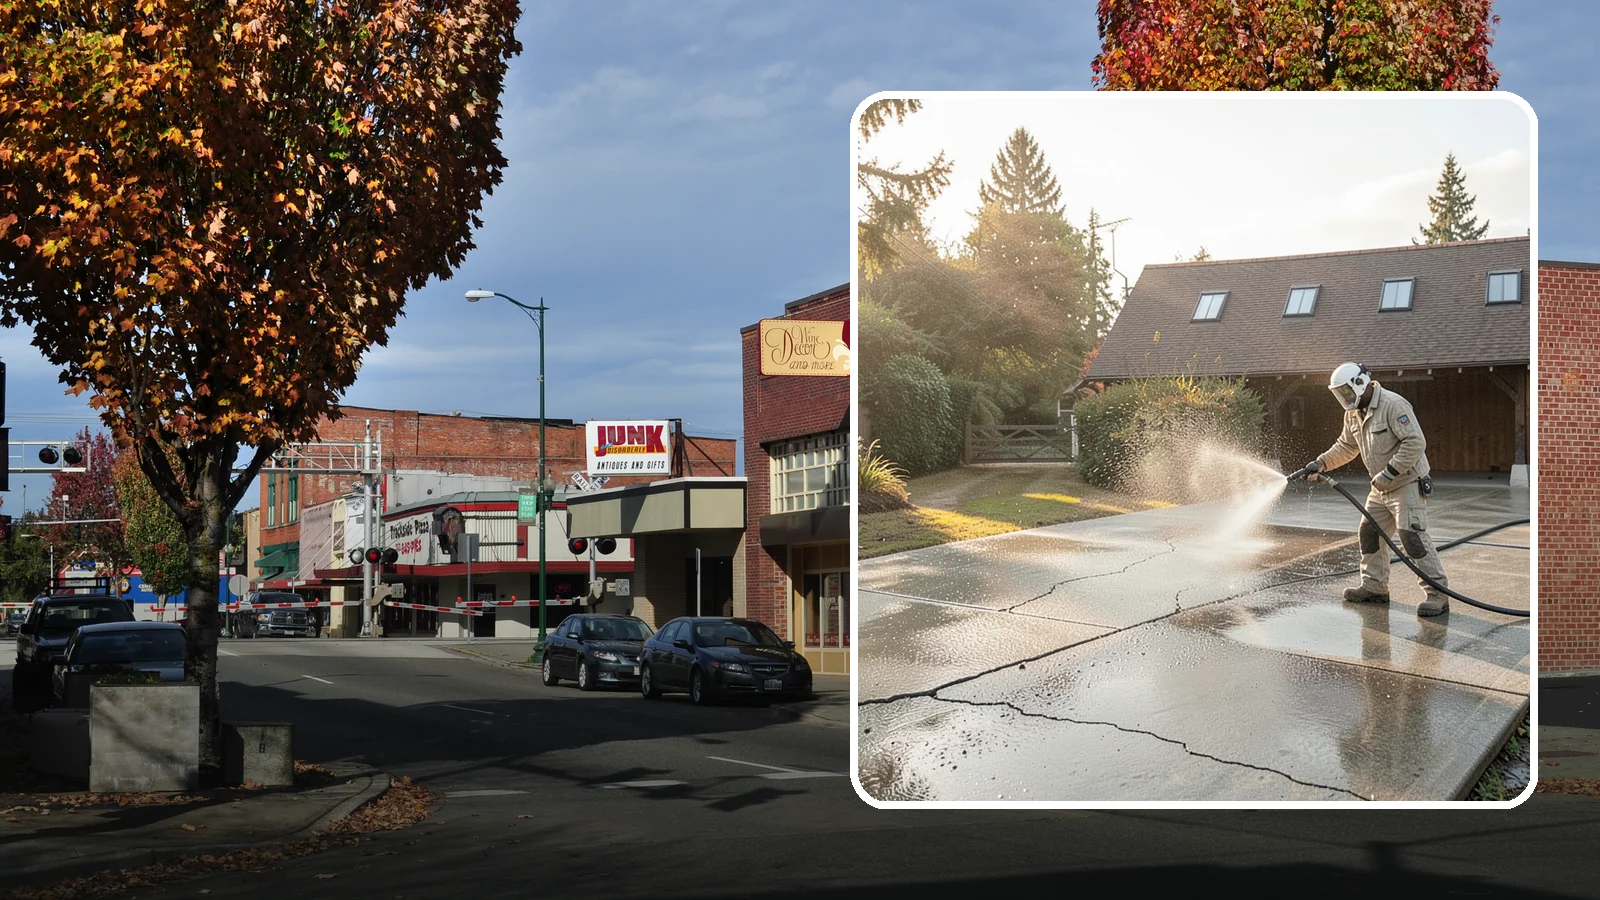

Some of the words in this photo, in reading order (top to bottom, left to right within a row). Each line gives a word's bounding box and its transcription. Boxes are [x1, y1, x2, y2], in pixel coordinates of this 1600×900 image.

[596, 425, 664, 457] JUNK
[597, 461, 628, 470] ANTIQUES
[631, 461, 644, 470] AND
[647, 460, 665, 470] GIFTS
[414, 519, 429, 535] Pizza
